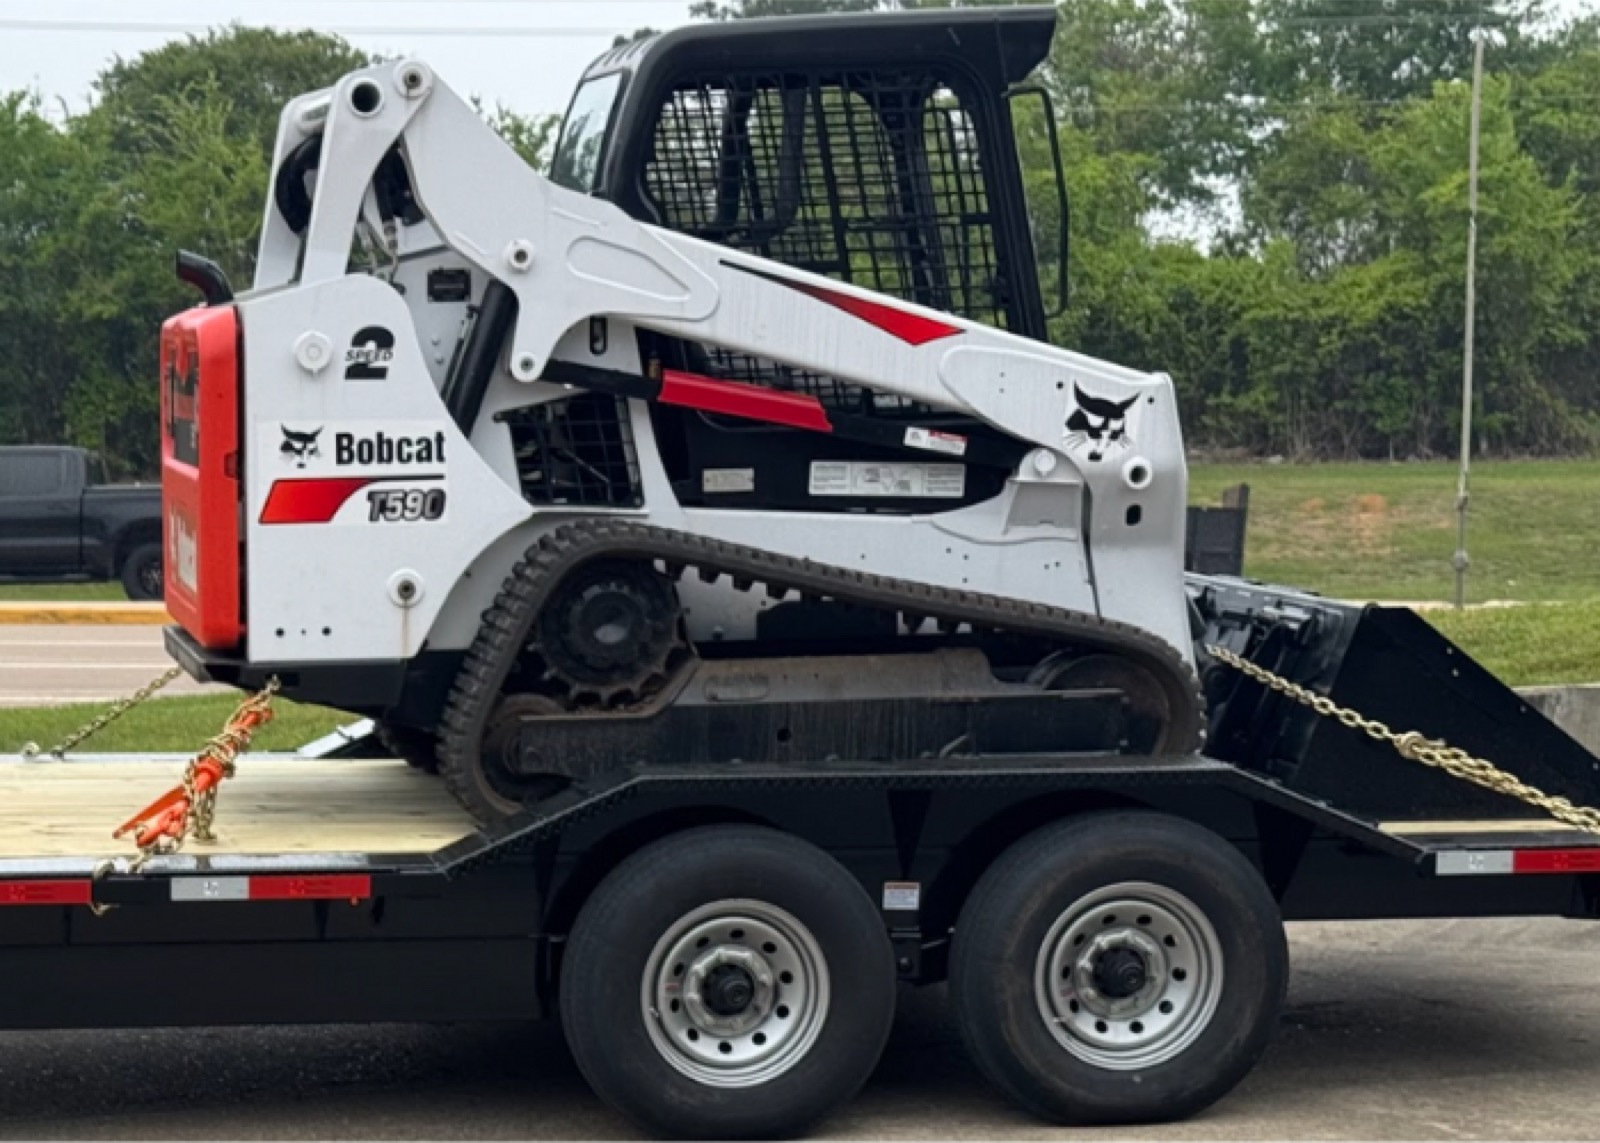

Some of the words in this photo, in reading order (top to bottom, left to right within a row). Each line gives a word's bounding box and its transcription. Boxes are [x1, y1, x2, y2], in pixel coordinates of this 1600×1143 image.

[345, 325, 395, 380] 2
[345, 349, 394, 361] SPEED
[335, 430, 446, 465] Bobcat
[366, 488, 447, 523] T590
